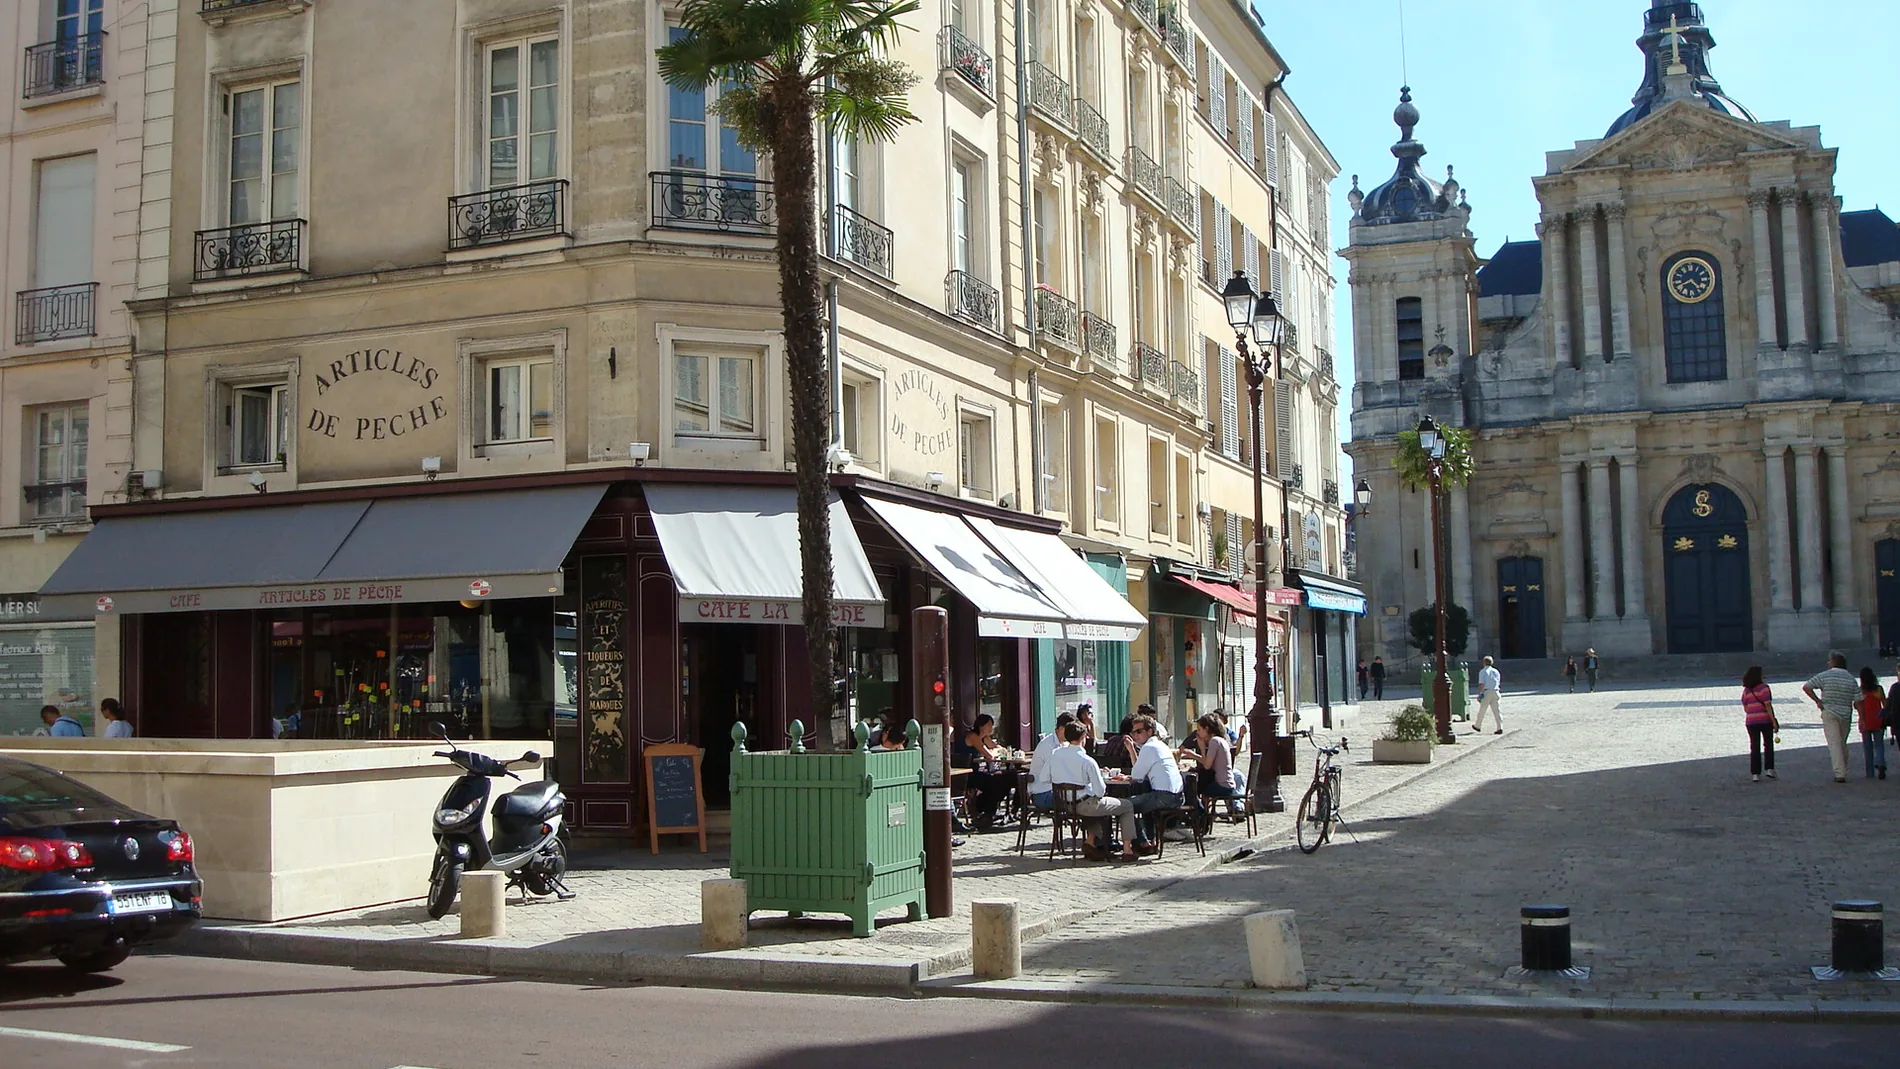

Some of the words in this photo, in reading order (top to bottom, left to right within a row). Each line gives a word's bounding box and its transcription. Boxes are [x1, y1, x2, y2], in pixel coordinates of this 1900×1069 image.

[315, 349, 439, 396] ARTICLES
[894, 369, 949, 420] ARTICLES
[306, 408, 340, 438] DE
[355, 395, 448, 440] PECHE
[892, 412, 907, 443] DE
[914, 428, 953, 455] PECHE
[260, 589, 326, 604] ARTICLES
[333, 586, 352, 601] DE
[762, 603, 789, 620] LA
[588, 651, 623, 661] LIQUEURS
[600, 676, 611, 686] DE
[590, 700, 623, 710] MARQUES
